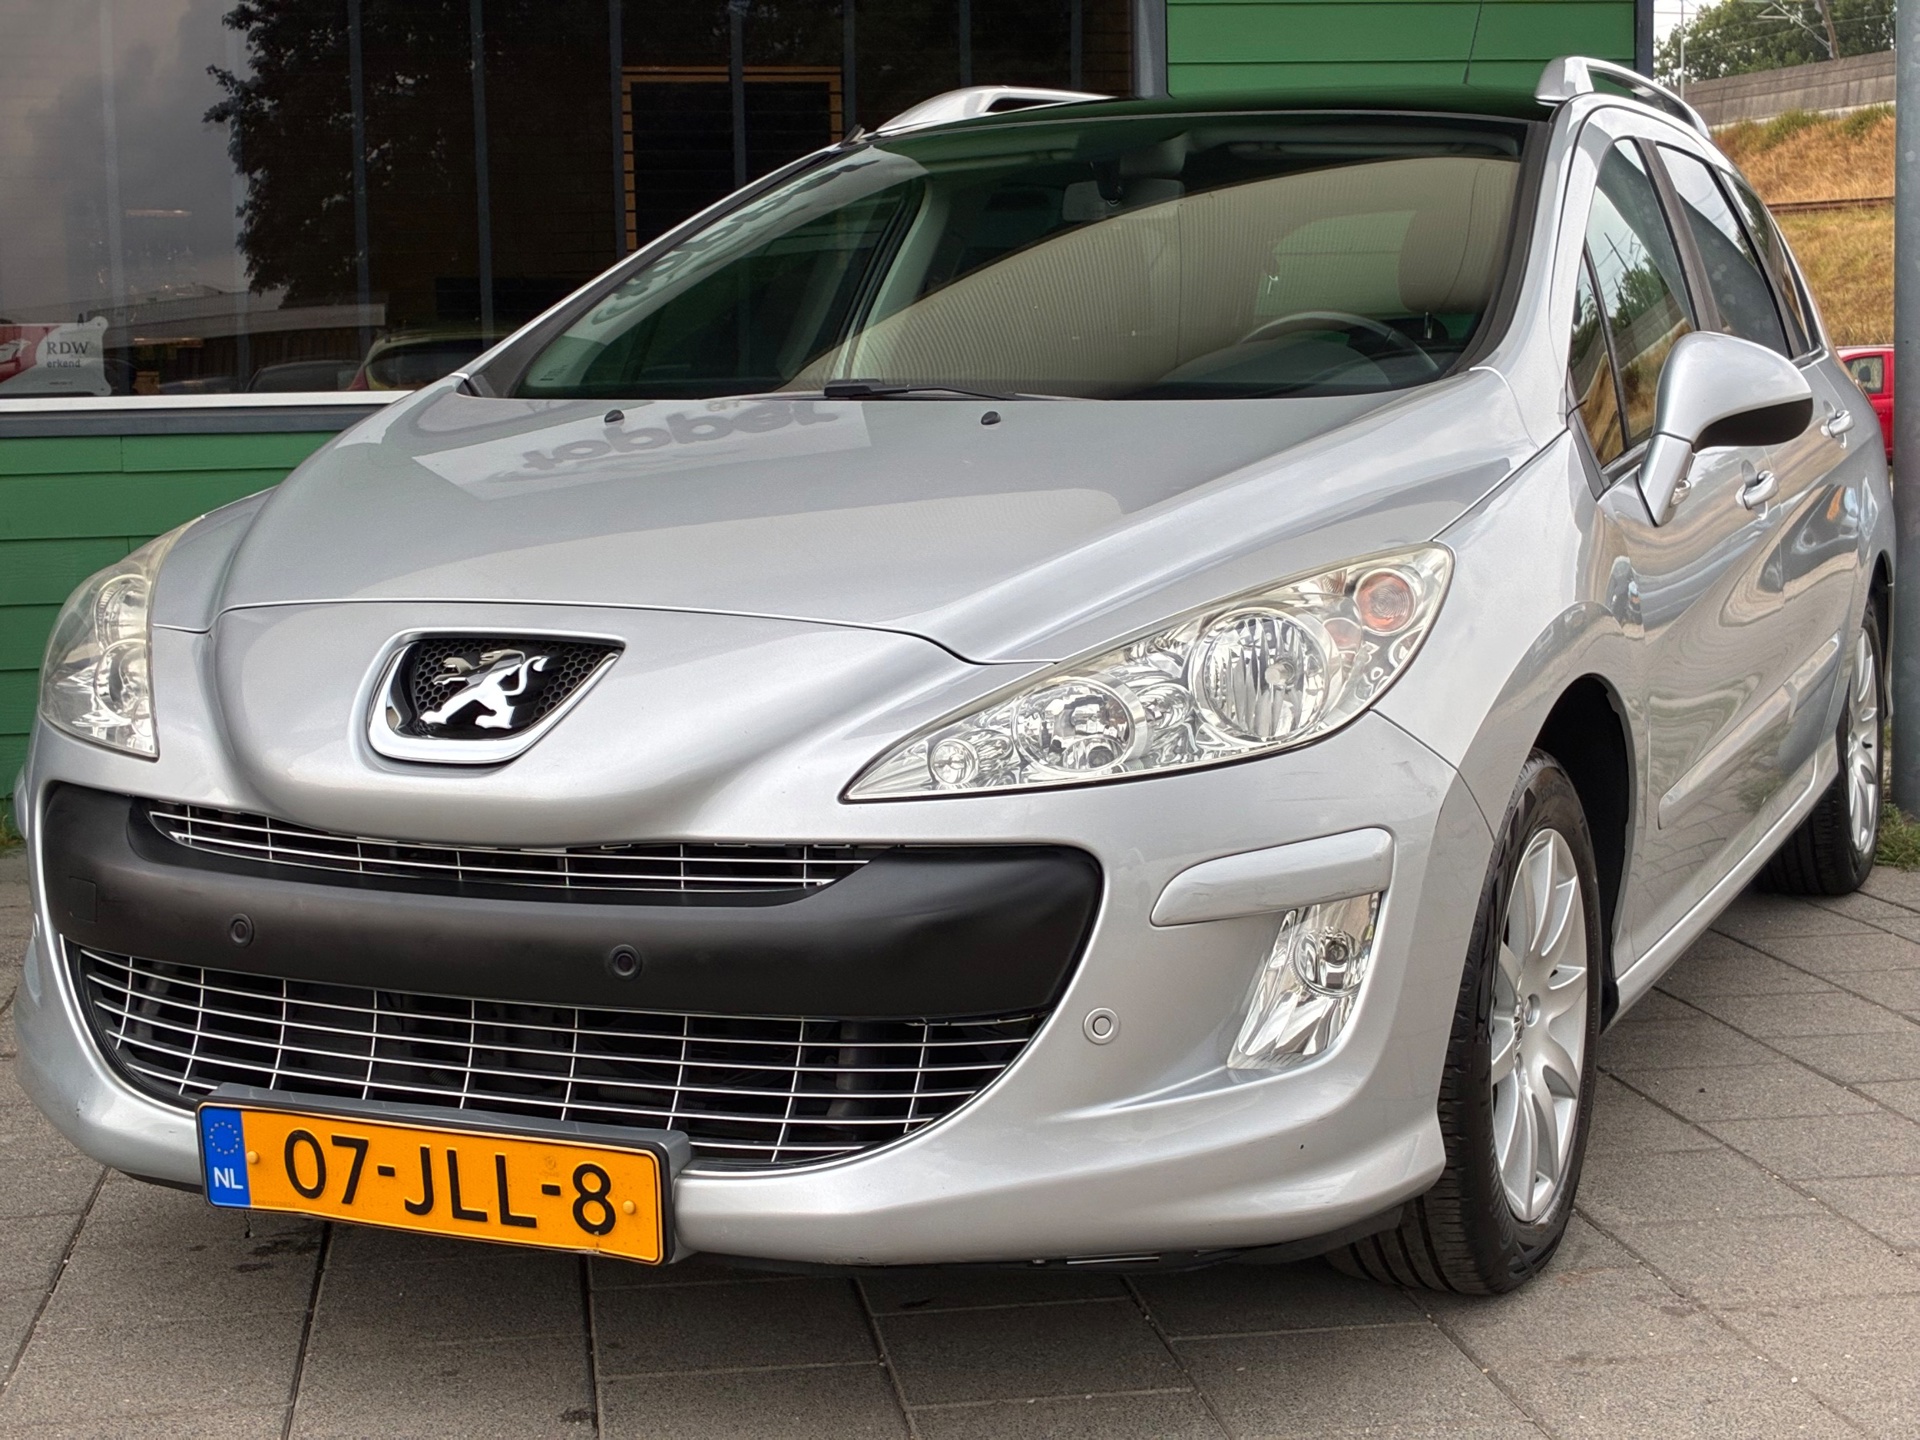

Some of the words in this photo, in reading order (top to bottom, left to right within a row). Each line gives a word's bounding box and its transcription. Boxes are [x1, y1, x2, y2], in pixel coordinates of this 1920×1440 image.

[47, 341, 89, 355] RDW
[47, 359, 81, 368] erkend
[213, 1167, 244, 1191] NL
[283, 1128, 617, 1237] 07-JLL-8
